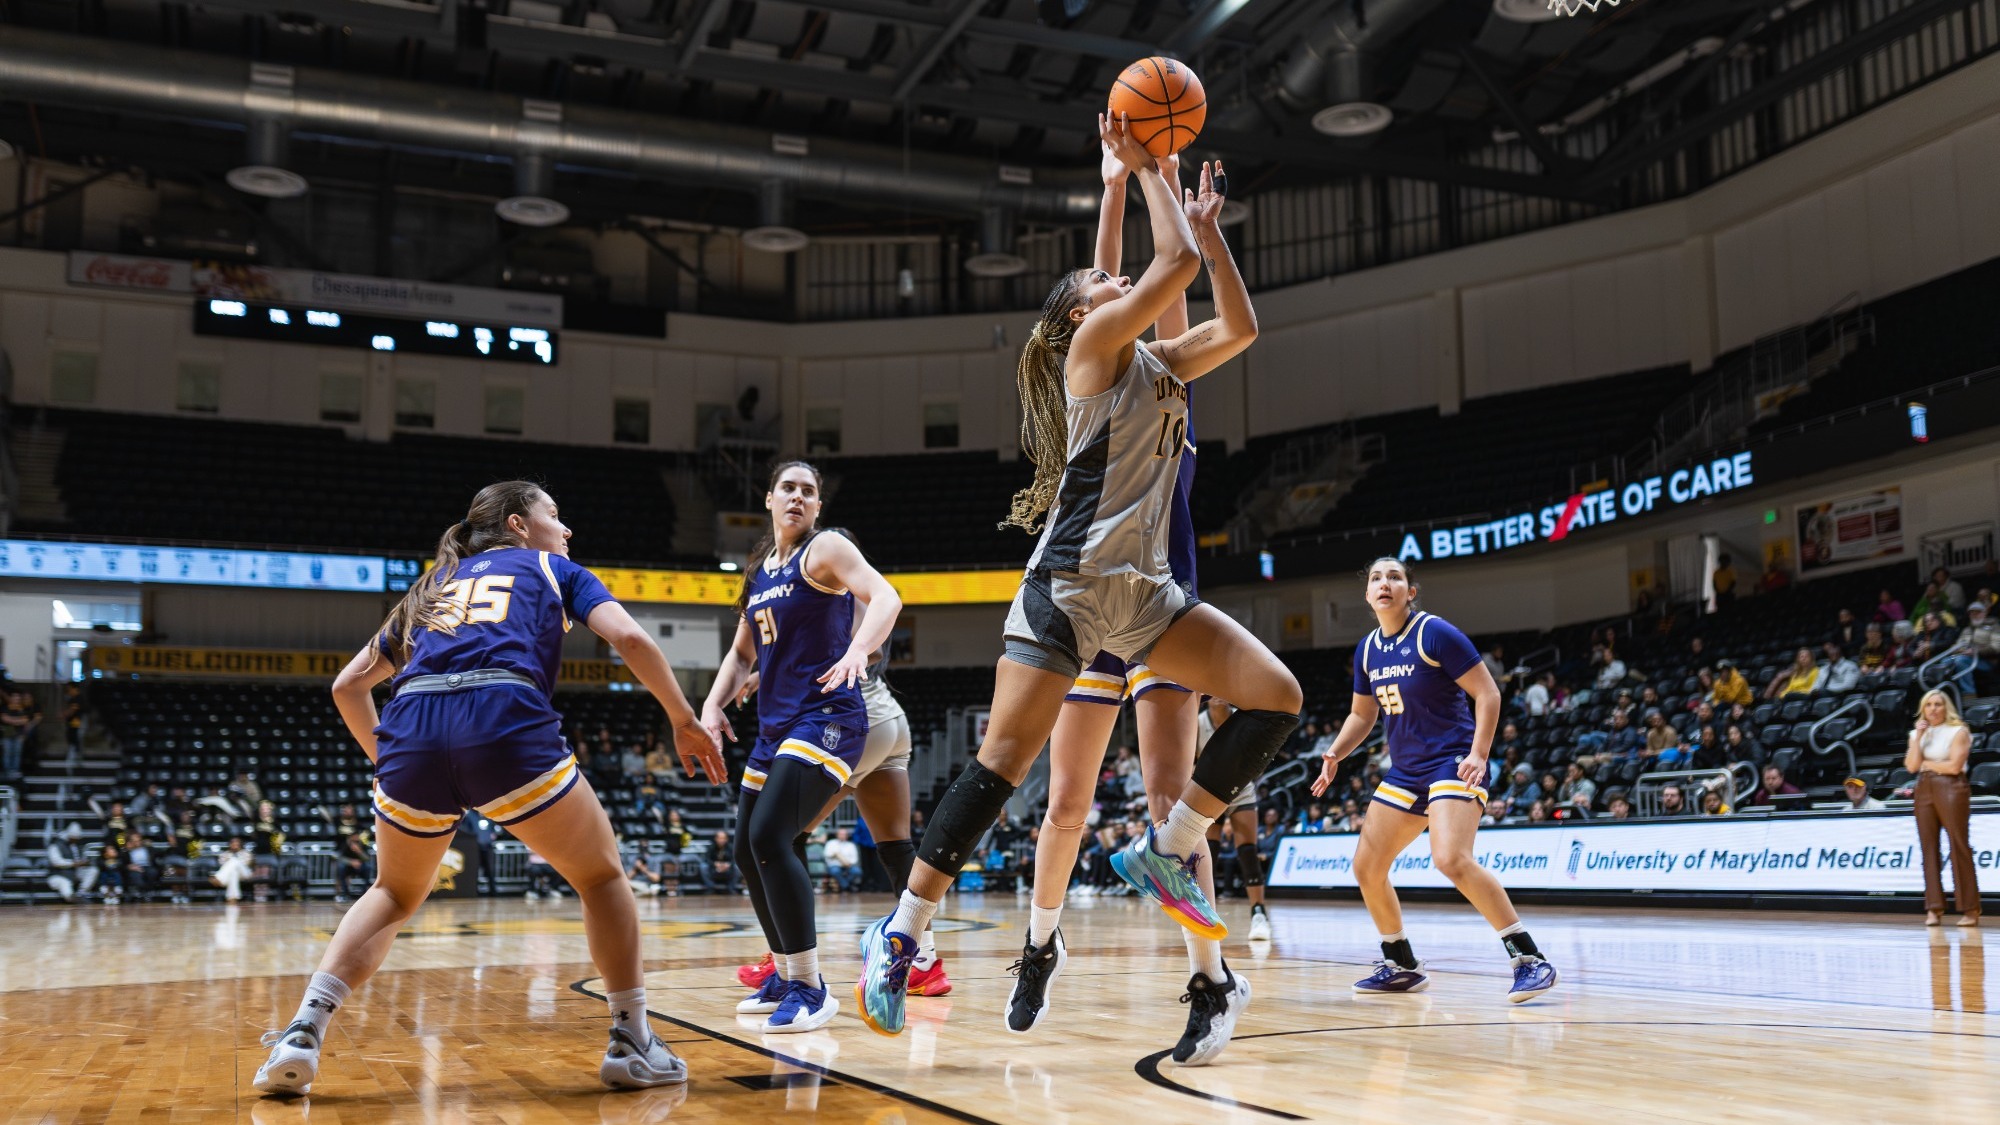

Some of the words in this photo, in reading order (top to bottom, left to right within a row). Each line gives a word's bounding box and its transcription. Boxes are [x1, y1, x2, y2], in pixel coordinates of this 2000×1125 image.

[1153, 408, 1184, 460] 10
[1398, 533, 1423, 561] A
[1431, 513, 1535, 559] BETTER
[1621, 476, 1662, 515] OF
[1669, 450, 1754, 503] CARE
[428, 575, 516, 632] 35
[754, 606, 778, 646] 21
[132, 650, 294, 674] WELCOME
[306, 653, 341, 675] TO
[1375, 683, 1405, 716] 33
[1296, 854, 1351, 873] University
[1393, 852, 1432, 873] yland
[1492, 852, 1548, 873] System
[1587, 849, 1678, 873] University
[1684, 848, 1706, 870] of
[1711, 847, 1812, 874] Maryland
[1817, 845, 1913, 869] Medical
